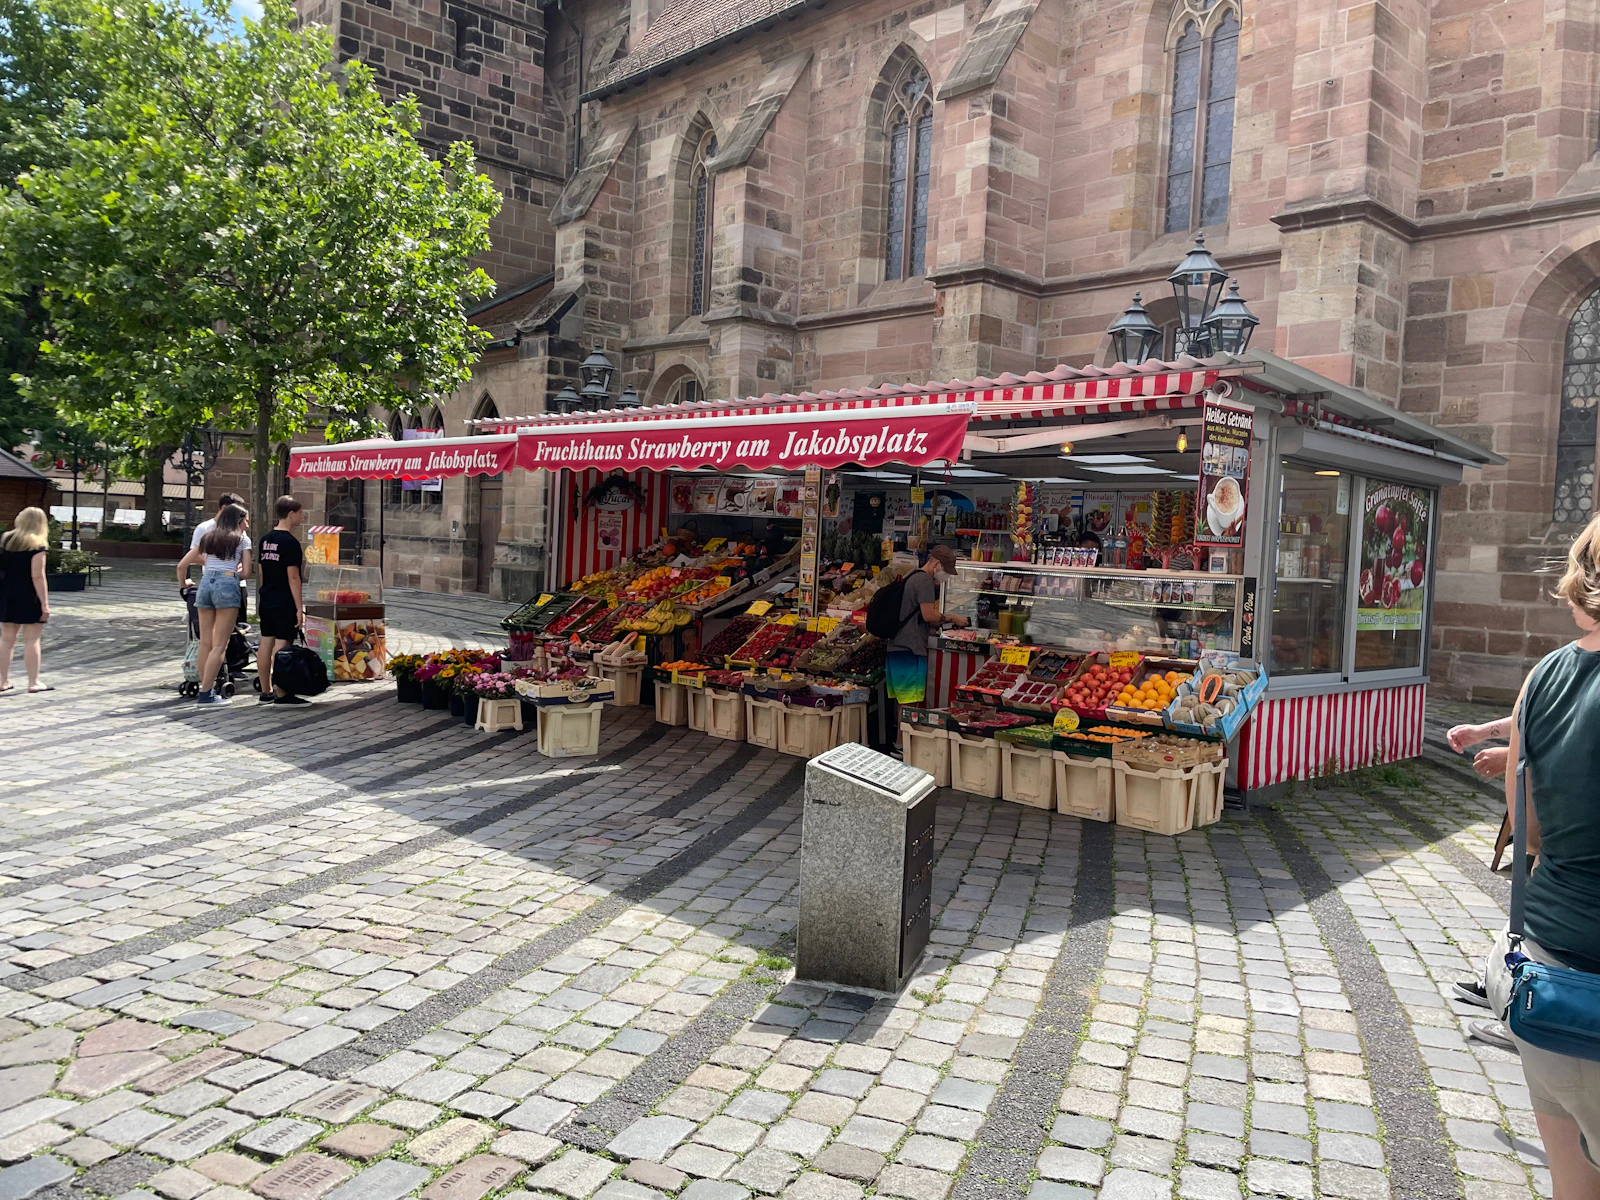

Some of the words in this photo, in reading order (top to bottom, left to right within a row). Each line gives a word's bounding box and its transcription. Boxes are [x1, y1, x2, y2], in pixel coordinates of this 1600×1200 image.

[1206, 407, 1227, 425] Heißes
[1227, 411, 1252, 430] Getränk
[533, 438, 624, 462] Fruchthaus
[627, 431, 732, 463] Strawberry
[735, 437, 769, 456] am
[778, 425, 928, 460] Jakobsplatz
[297, 455, 347, 473] Fruchthaus
[348, 453, 403, 474] Strawberry
[404, 457, 422, 470] am
[425, 449, 498, 472] Jakobsplatz
[1366, 484, 1409, 512] Granatapfel
[1409, 491, 1427, 522] Säfte
[259, 1122, 303, 1148] MARION
[554, 1156, 600, 1190] THORSTEN
